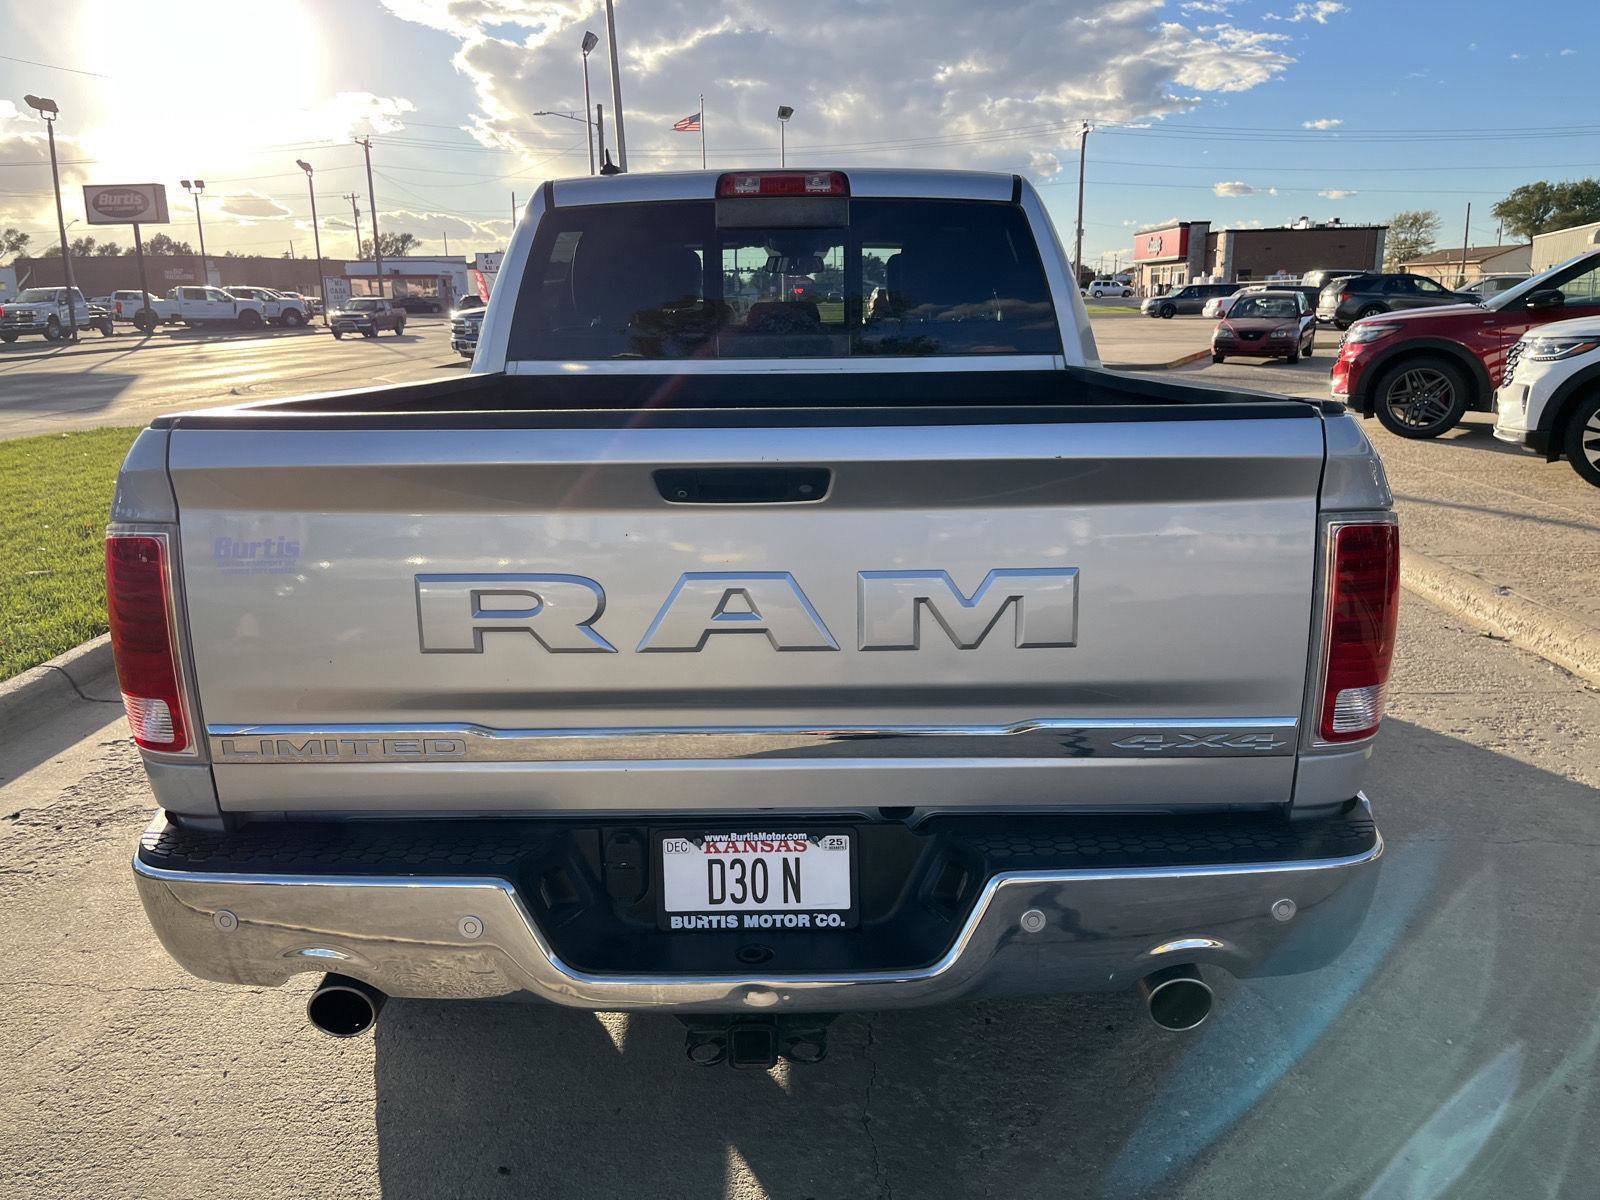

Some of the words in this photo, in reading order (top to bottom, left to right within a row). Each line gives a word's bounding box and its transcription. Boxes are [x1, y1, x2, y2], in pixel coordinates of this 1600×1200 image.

[98, 192, 142, 206] Burtis
[213, 536, 301, 560] Burtis
[414, 566, 1080, 653] RAM
[221, 738, 467, 757] LIMITED
[704, 832, 808, 842] www.BurtisMotor.com
[828, 838, 843, 846] 25
[666, 841, 688, 853] DEC
[703, 839, 808, 855] KANSAS
[707, 858, 769, 905] D30
[782, 857, 802, 904] N
[670, 914, 739, 929] BURTIS
[743, 914, 811, 929] MOTOR
[814, 913, 846, 928] CO.
